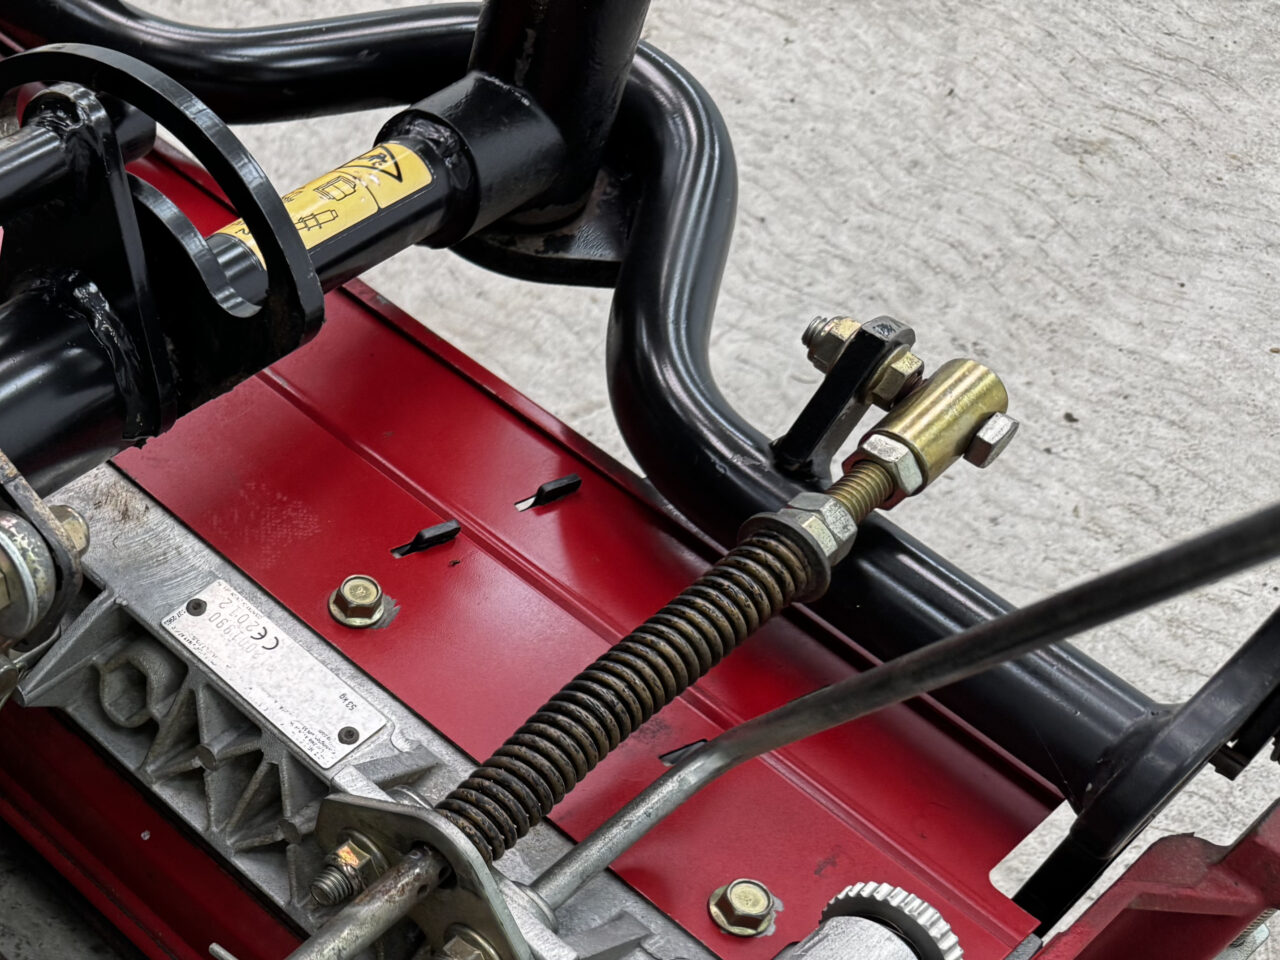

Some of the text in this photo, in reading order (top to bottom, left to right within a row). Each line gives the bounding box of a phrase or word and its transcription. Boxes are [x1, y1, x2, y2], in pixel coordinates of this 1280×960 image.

[219, 598, 260, 632] 2012
[339, 692, 357, 711] 53 kg
